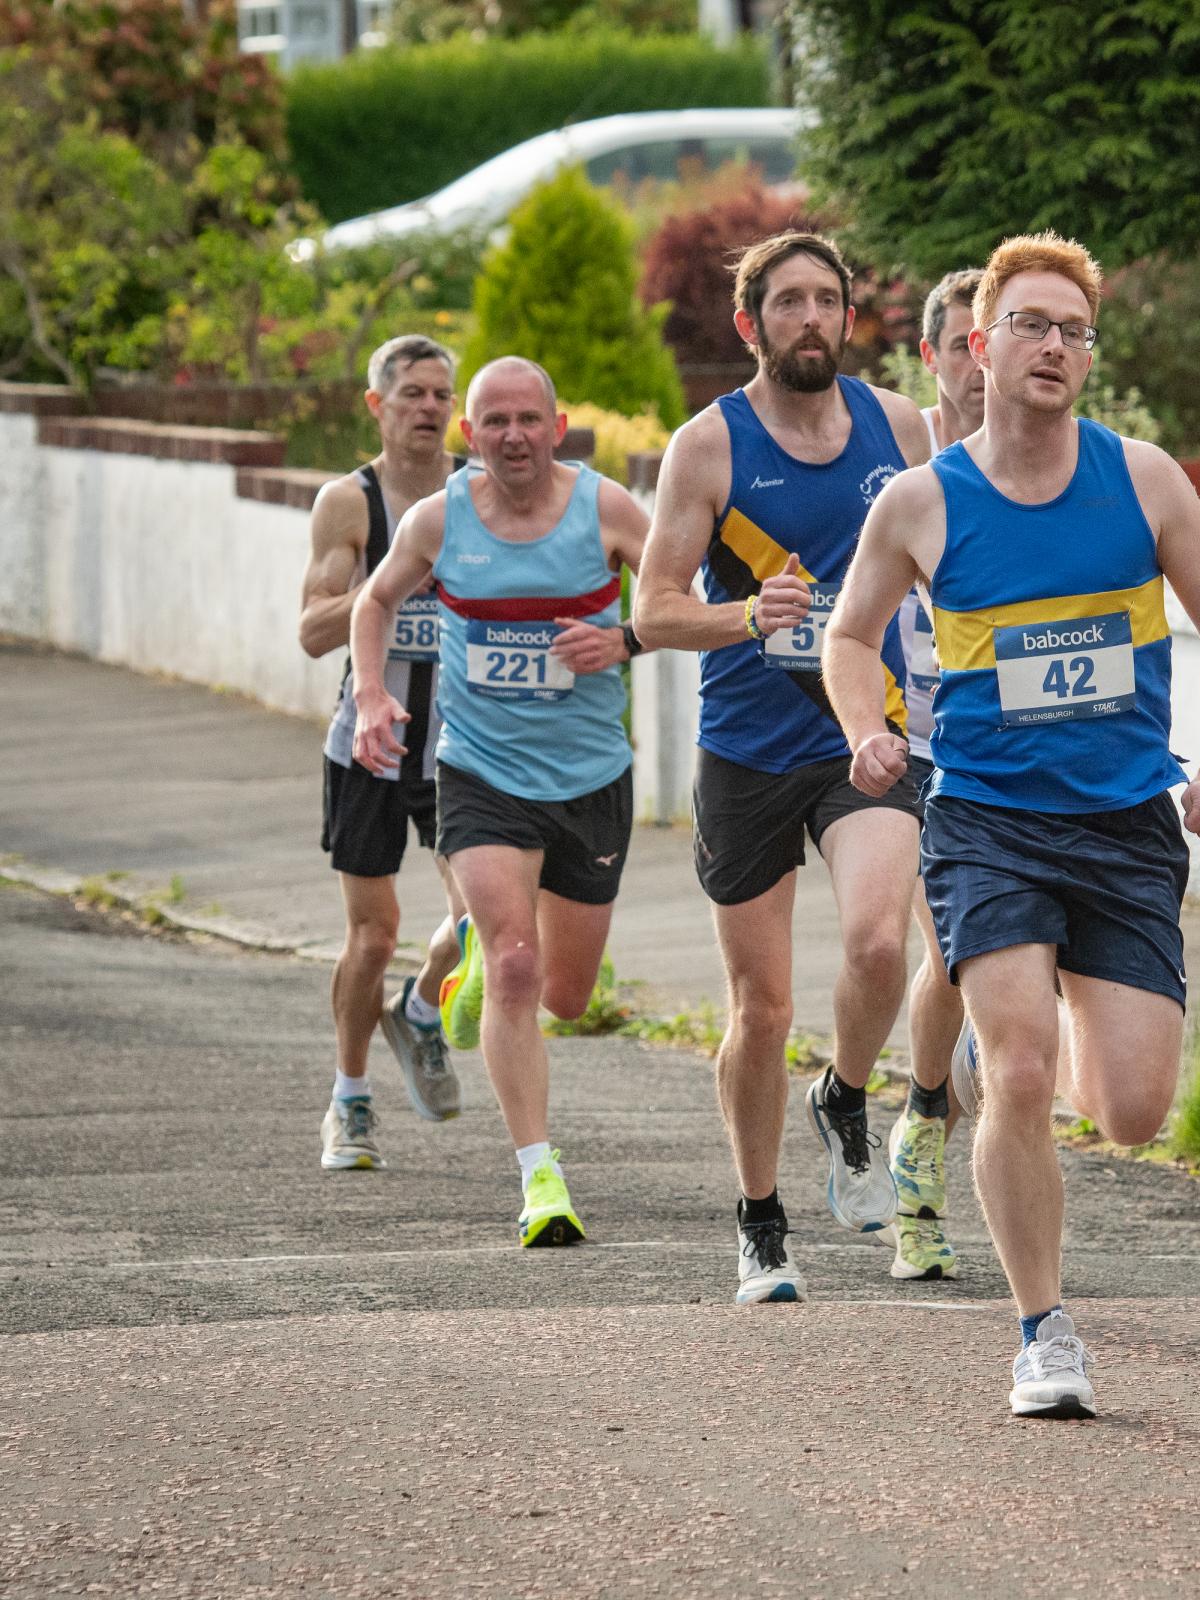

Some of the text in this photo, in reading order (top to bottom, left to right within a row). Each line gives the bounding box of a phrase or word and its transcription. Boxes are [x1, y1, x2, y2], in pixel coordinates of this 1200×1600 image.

[486, 627, 551, 646] babcock
[1023, 624, 1104, 651] babcock
[486, 652, 546, 683] 221
[1042, 656, 1097, 699] 42
[1018, 710, 1074, 722] HELENSBURGH
[1092, 701, 1117, 712] START
